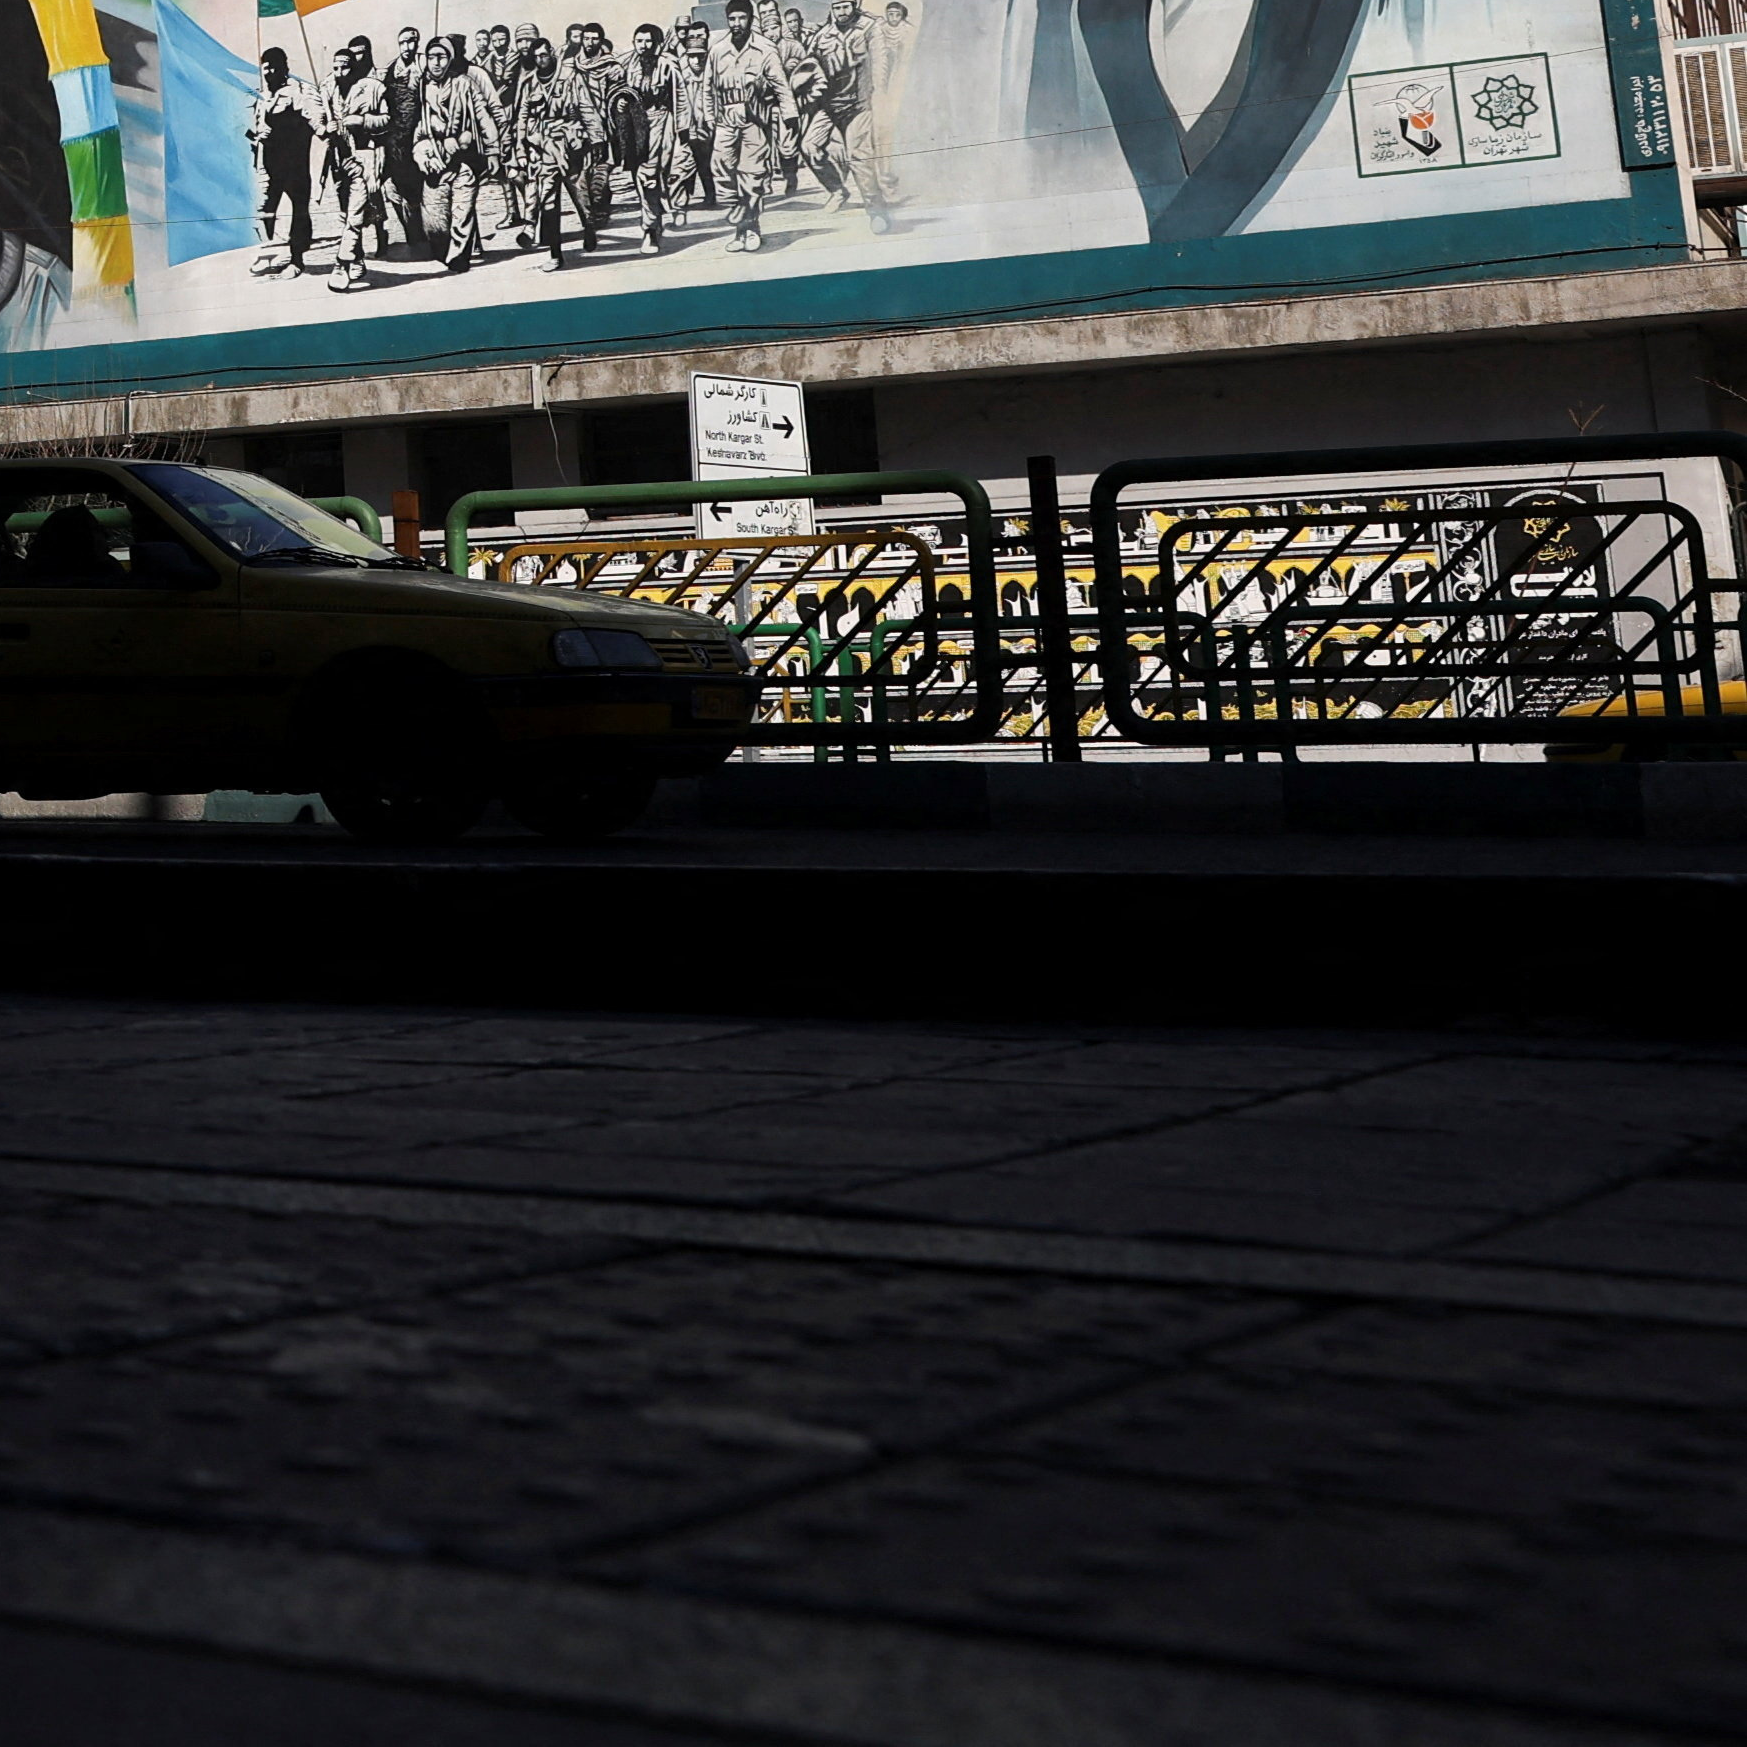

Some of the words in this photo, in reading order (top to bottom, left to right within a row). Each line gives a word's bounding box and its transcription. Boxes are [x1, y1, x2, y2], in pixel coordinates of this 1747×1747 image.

[1374, 137, 1399, 149] شهید
[1483, 144, 1508, 156] تهران
[1508, 142, 1529, 155] شهر
[703, 383, 734, 398] شمالی
[735, 387, 757, 401] کارگر
[726, 410, 758, 425] کشاورز
[705, 429, 726, 442] North
[728, 432, 753, 445] Kargar
[754, 434, 764, 444] St.
[706, 446, 747, 460] Keshavarz
[755, 501, 775, 517] آهن
[775, 503, 788, 518] راه
[736, 522, 759, 533] South
[761, 524, 786, 536] Kargar
